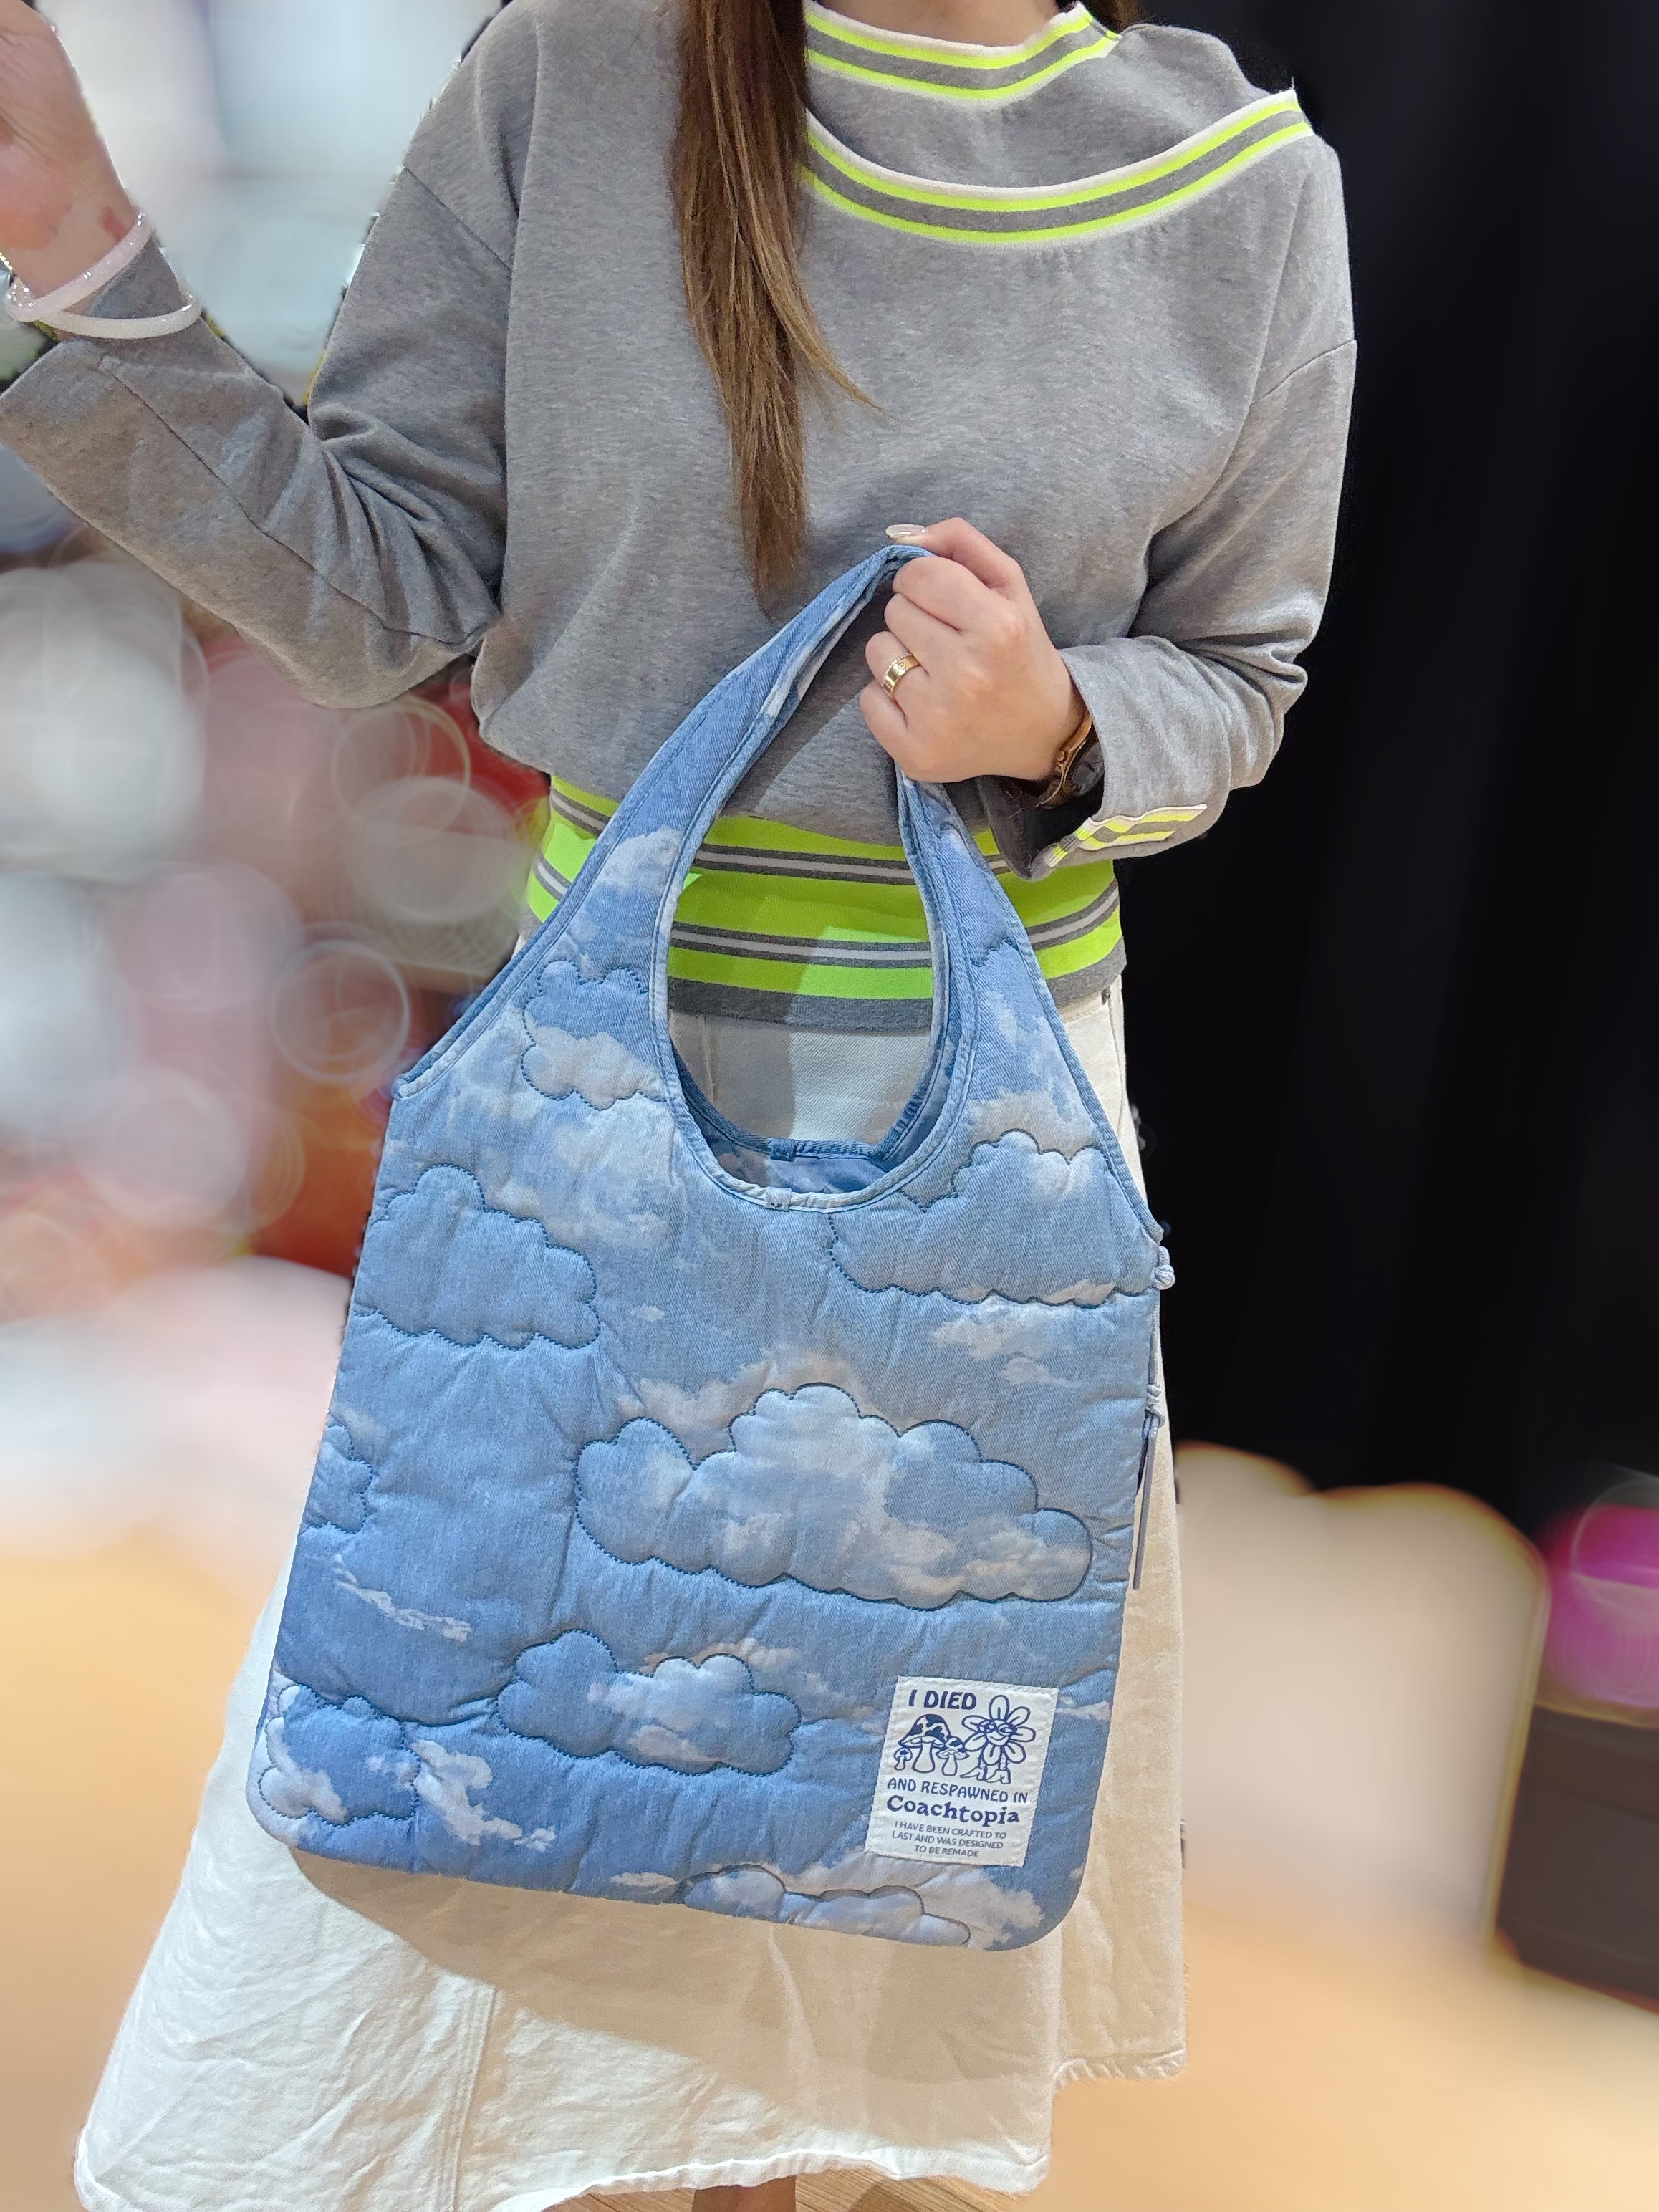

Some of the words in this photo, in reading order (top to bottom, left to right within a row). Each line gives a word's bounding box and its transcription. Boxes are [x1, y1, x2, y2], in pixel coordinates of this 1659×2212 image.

[909, 1689, 917, 1706] I
[923, 1690, 976, 1710] DIED
[887, 1778, 916, 1791] AND
[921, 1781, 1009, 1802] RESPAWNED
[1014, 1792, 1028, 1803] IN
[887, 1795, 1020, 1827] Coachtopia
[900, 1822, 924, 1832] HAVE
[926, 1825, 950, 1834] BEEN
[951, 1828, 992, 1838] CRAFTED
[892, 1831, 914, 1840] LAST
[914, 1834, 934, 1843] AND
[936, 1837, 956, 1845] WAS
[959, 1840, 1003, 1849] DESIGNED
[941, 1848, 978, 1857] REMADE
